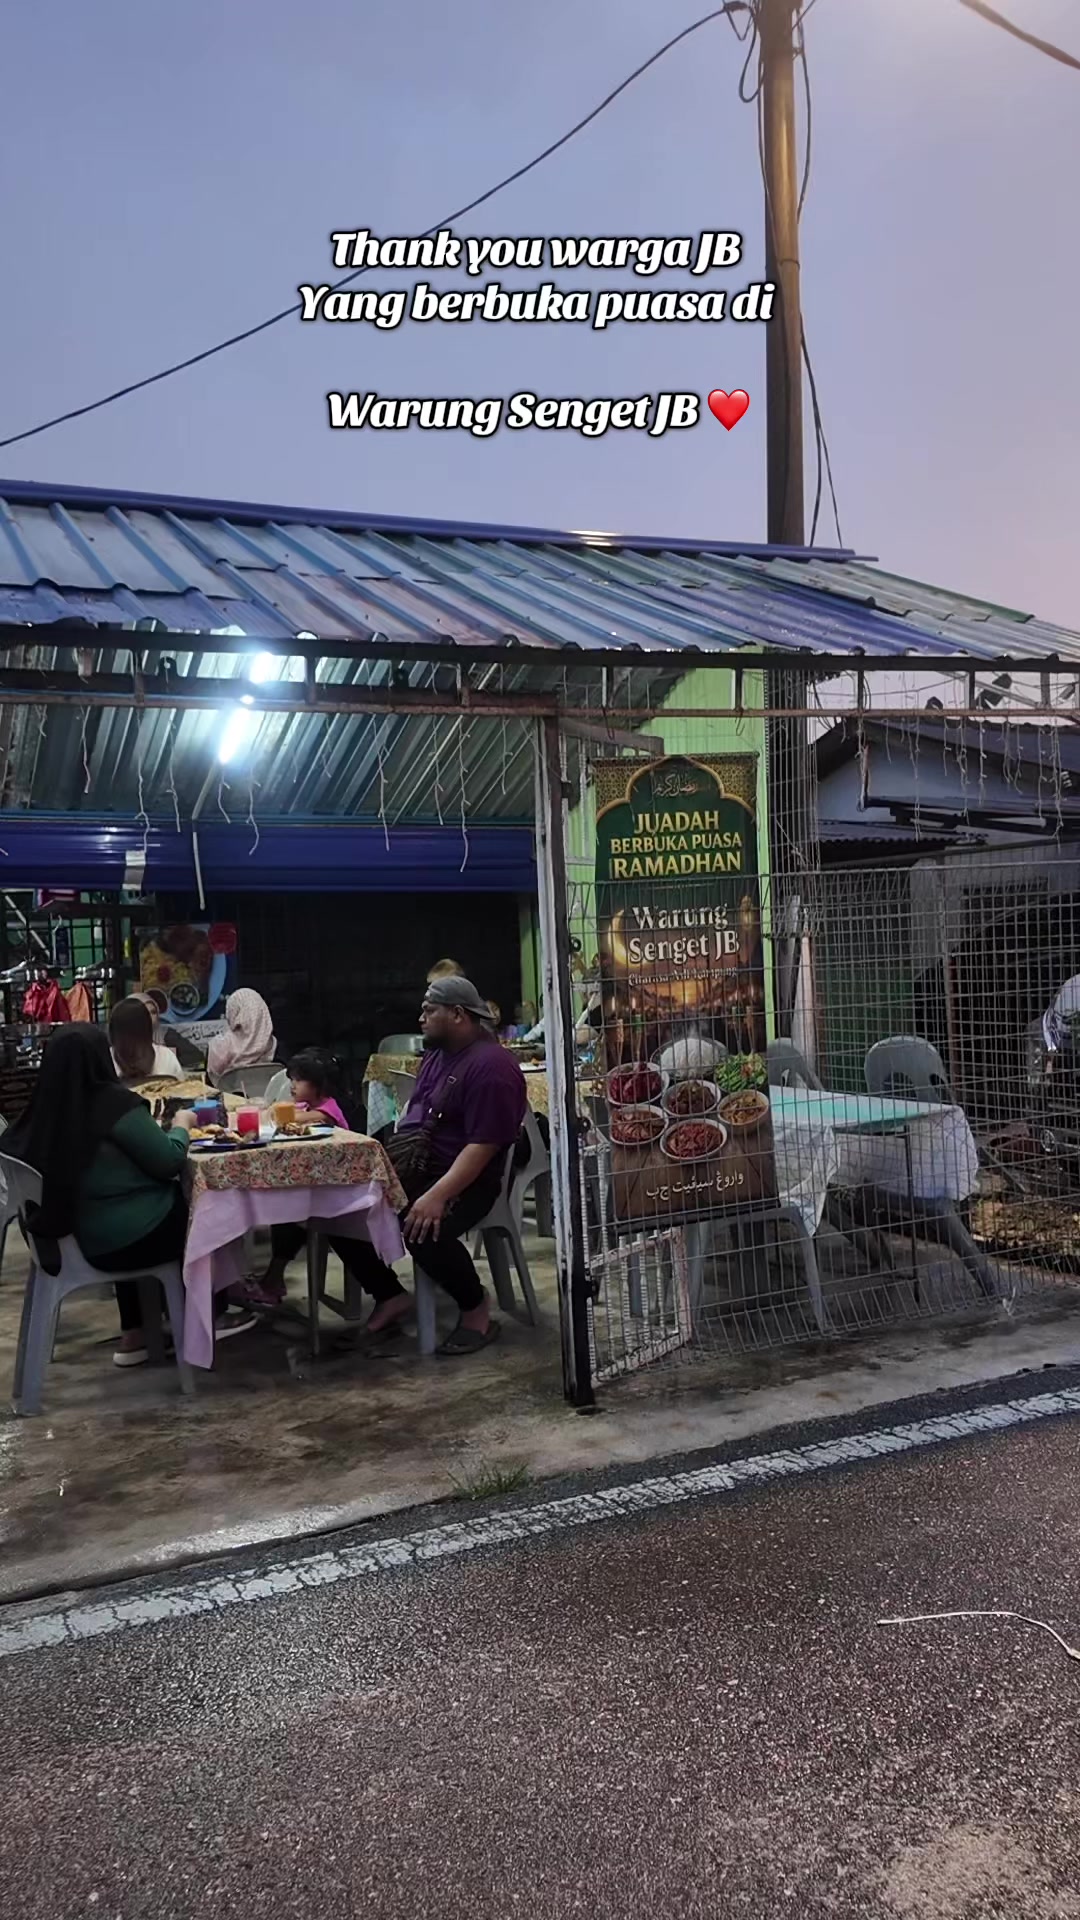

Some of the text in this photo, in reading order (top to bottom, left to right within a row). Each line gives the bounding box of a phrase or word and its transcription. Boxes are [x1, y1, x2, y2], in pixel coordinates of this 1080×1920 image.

[633, 810, 720, 834] JUADAH
[610, 831, 742, 854] BERBUKA PUASA
[632, 902, 729, 930] Warung
[629, 930, 740, 964] Senget JB
